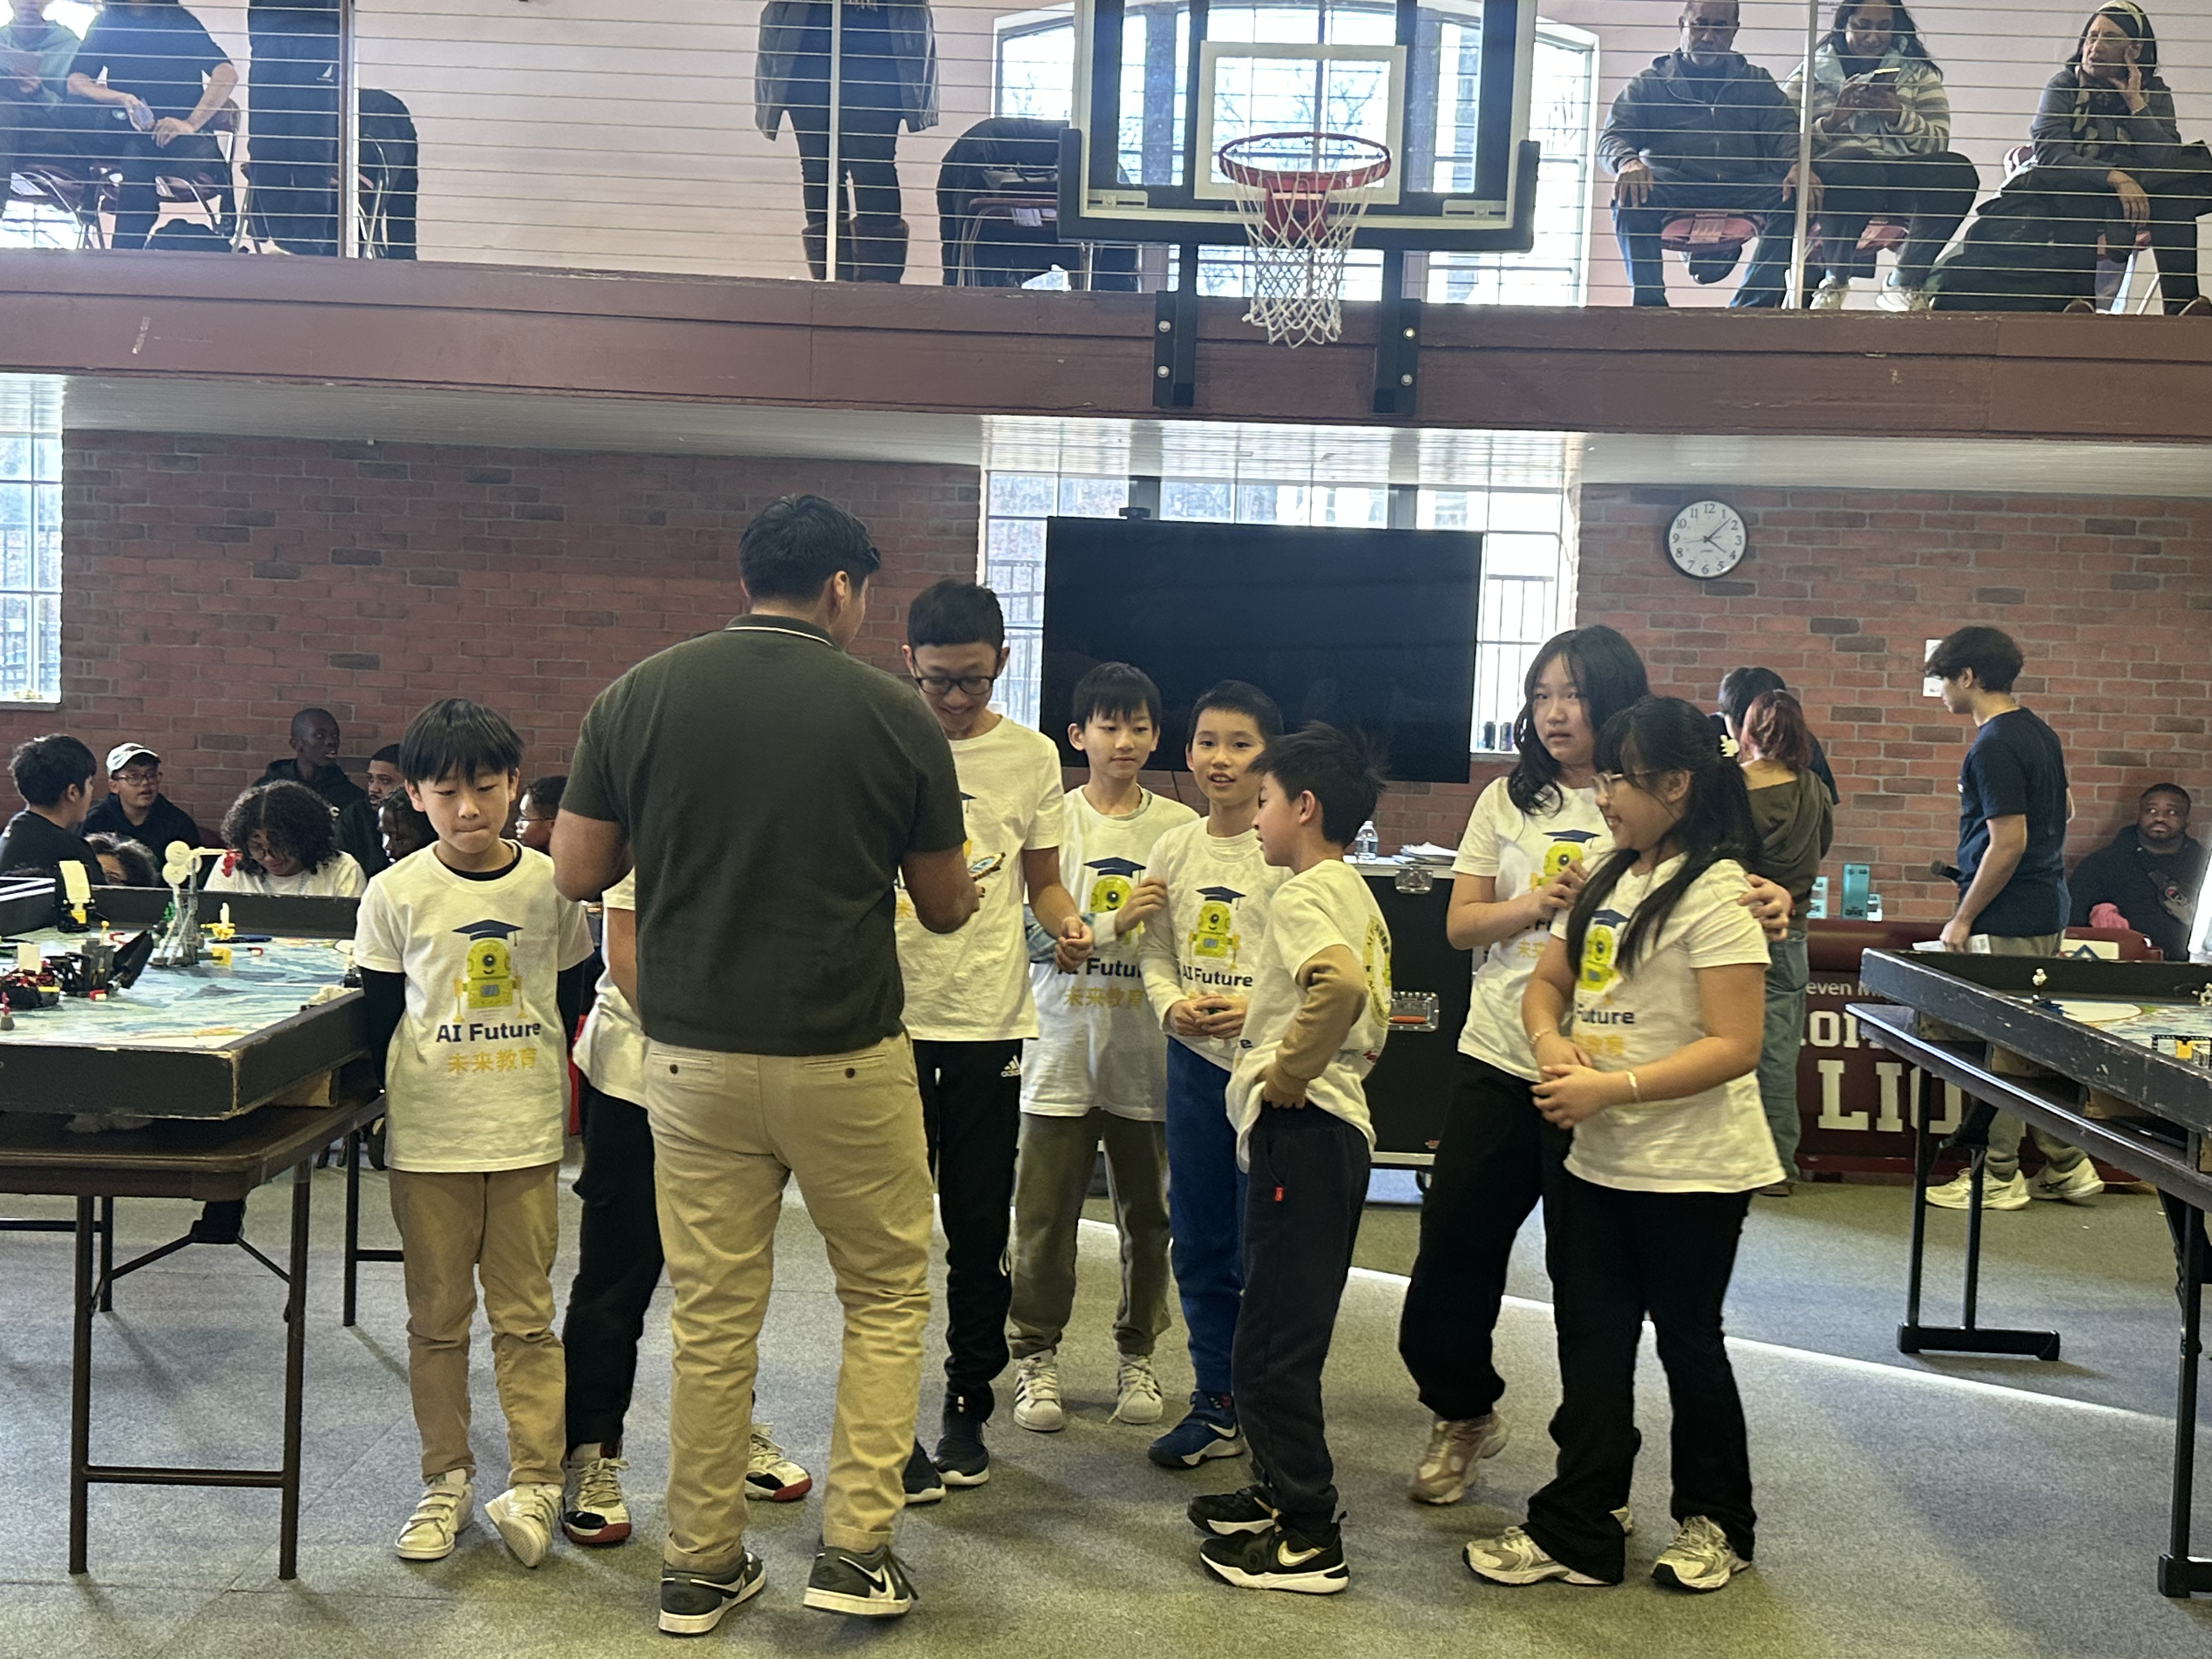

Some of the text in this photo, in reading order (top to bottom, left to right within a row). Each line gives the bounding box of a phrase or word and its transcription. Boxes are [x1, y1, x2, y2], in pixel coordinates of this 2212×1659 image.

[1690, 508, 1699, 518] 11
[1703, 503, 1716, 514] 12
[1722, 509, 1726, 520] 1
[1675, 518, 1687, 529] 10
[1730, 520, 1739, 531] 2
[1672, 533, 1680, 544] 9
[1735, 535, 1742, 546] 3
[1675, 548, 1684, 558] 8
[1729, 550, 1736, 560] 4
[1687, 560, 1695, 571] 7
[1701, 564, 1709, 575] 6
[1717, 561, 1725, 572] 5
[1086, 957, 1142, 978] Futu
[1194, 967, 1254, 987] Future
[1805, 981, 1852, 995] even
[436, 1022, 541, 1043] AI Future
[448, 1047, 538, 1075] 未来教育
[1818, 1059, 1962, 1135] LIO
